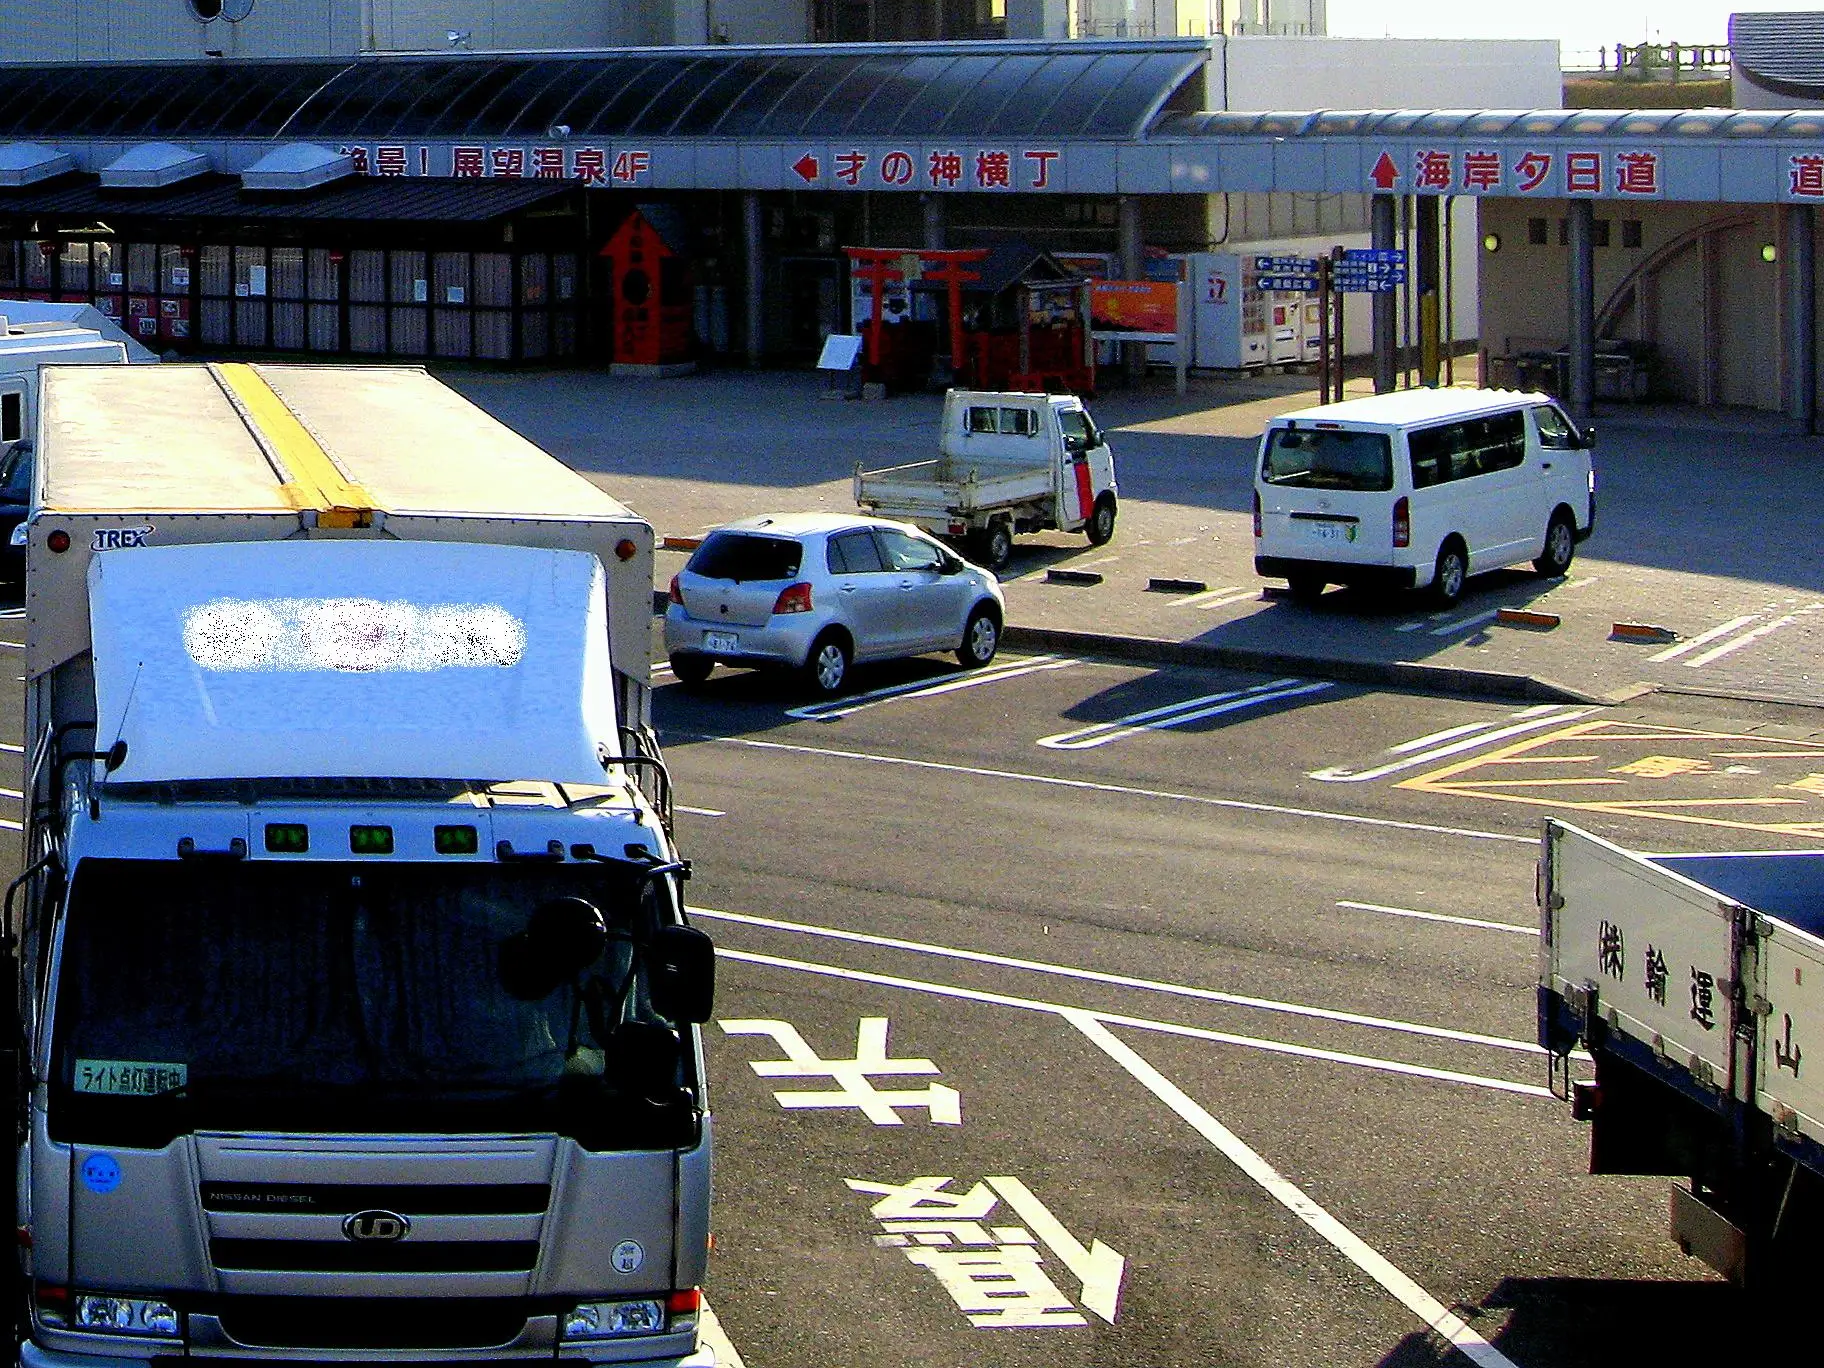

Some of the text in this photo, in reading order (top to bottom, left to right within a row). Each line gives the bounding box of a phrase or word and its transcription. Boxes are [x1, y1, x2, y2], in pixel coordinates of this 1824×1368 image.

[451, 145, 651, 187] 展望温泉4F
[835, 149, 1060, 189] 才の神横丁
[1415, 149, 1658, 194] 海岸夕日道
[95, 527, 149, 549] TREX
[209, 1191, 316, 1204] NISSAN DIESEL
[353, 1218, 401, 1239] UD
